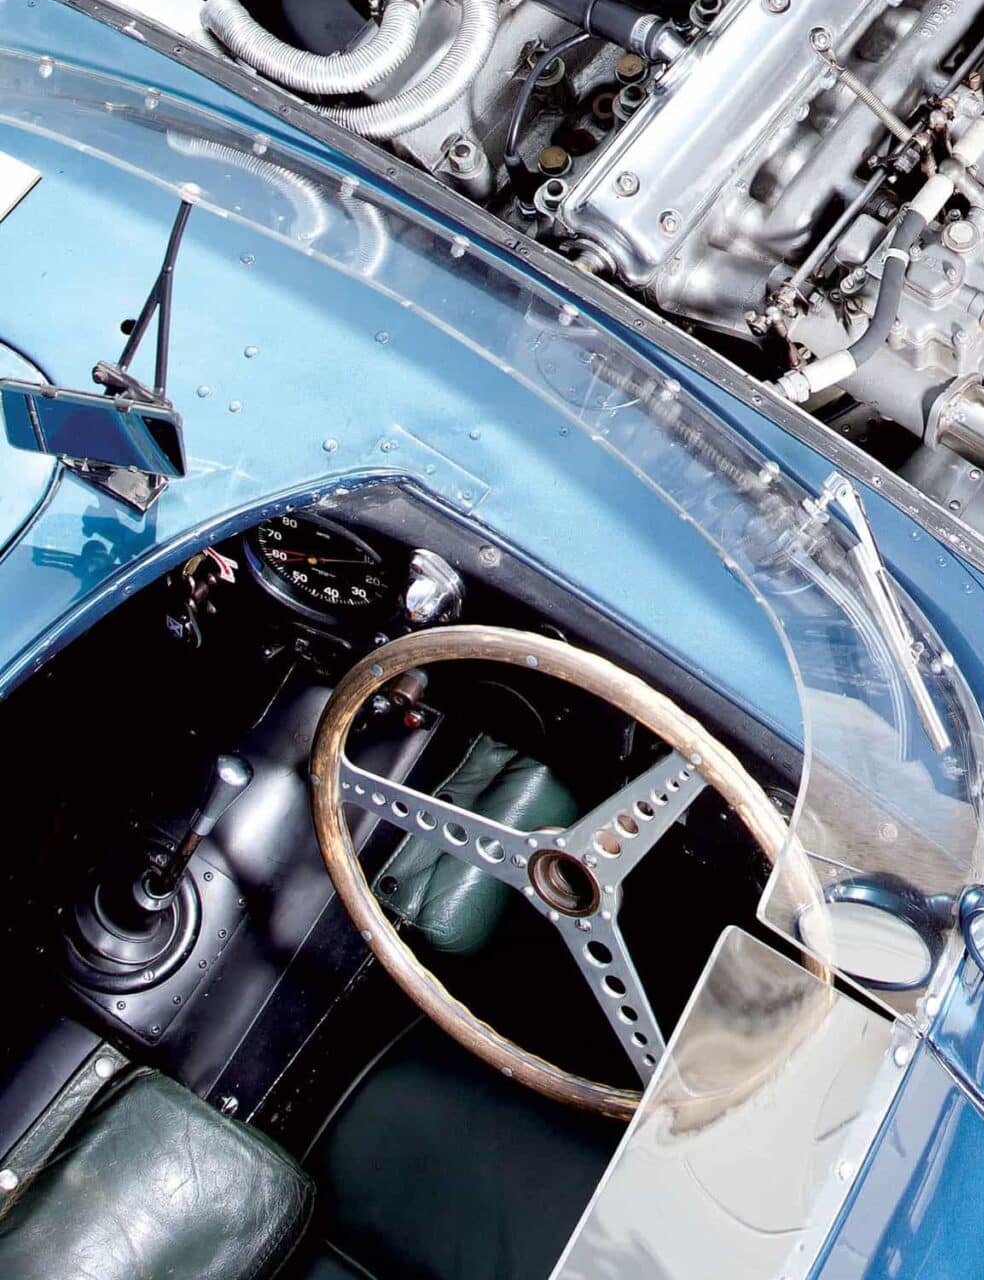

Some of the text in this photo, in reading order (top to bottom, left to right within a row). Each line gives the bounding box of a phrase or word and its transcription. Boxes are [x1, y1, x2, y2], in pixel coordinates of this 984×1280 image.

[282, 516, 298, 529] 80
[266, 528, 282, 541] 70
[292, 570, 308, 583] 50
[365, 575, 381, 586] 20
[323, 587, 340, 599] 40
[351, 586, 367, 598] 30
